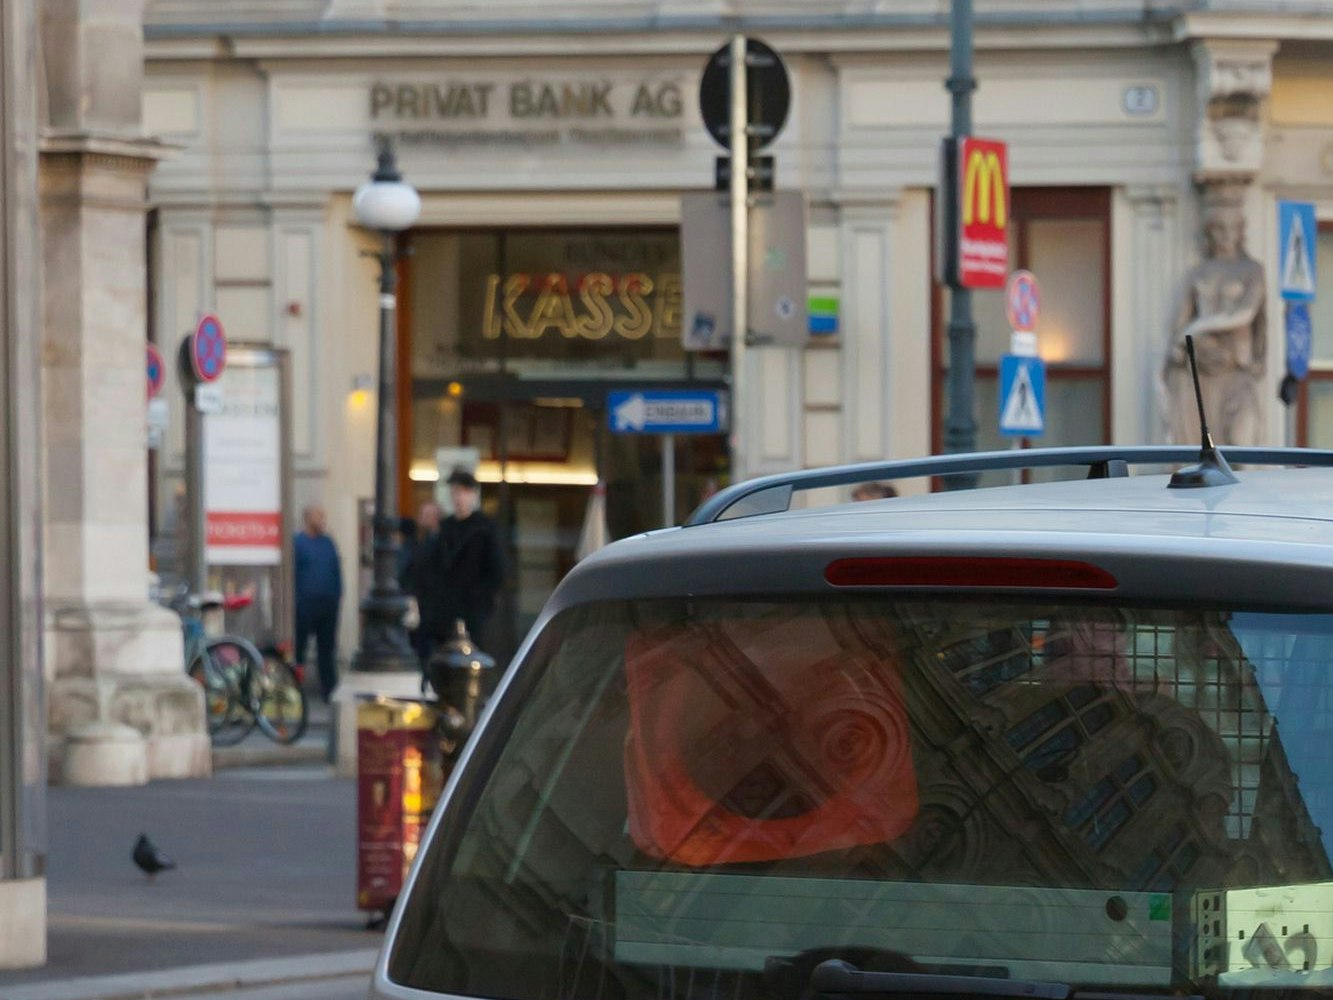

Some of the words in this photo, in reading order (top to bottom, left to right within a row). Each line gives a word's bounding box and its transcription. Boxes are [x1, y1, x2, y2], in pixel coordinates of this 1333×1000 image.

[371, 82, 494, 119] PRIVAT
[508, 82, 613, 119] BANK
[631, 83, 683, 119] AG
